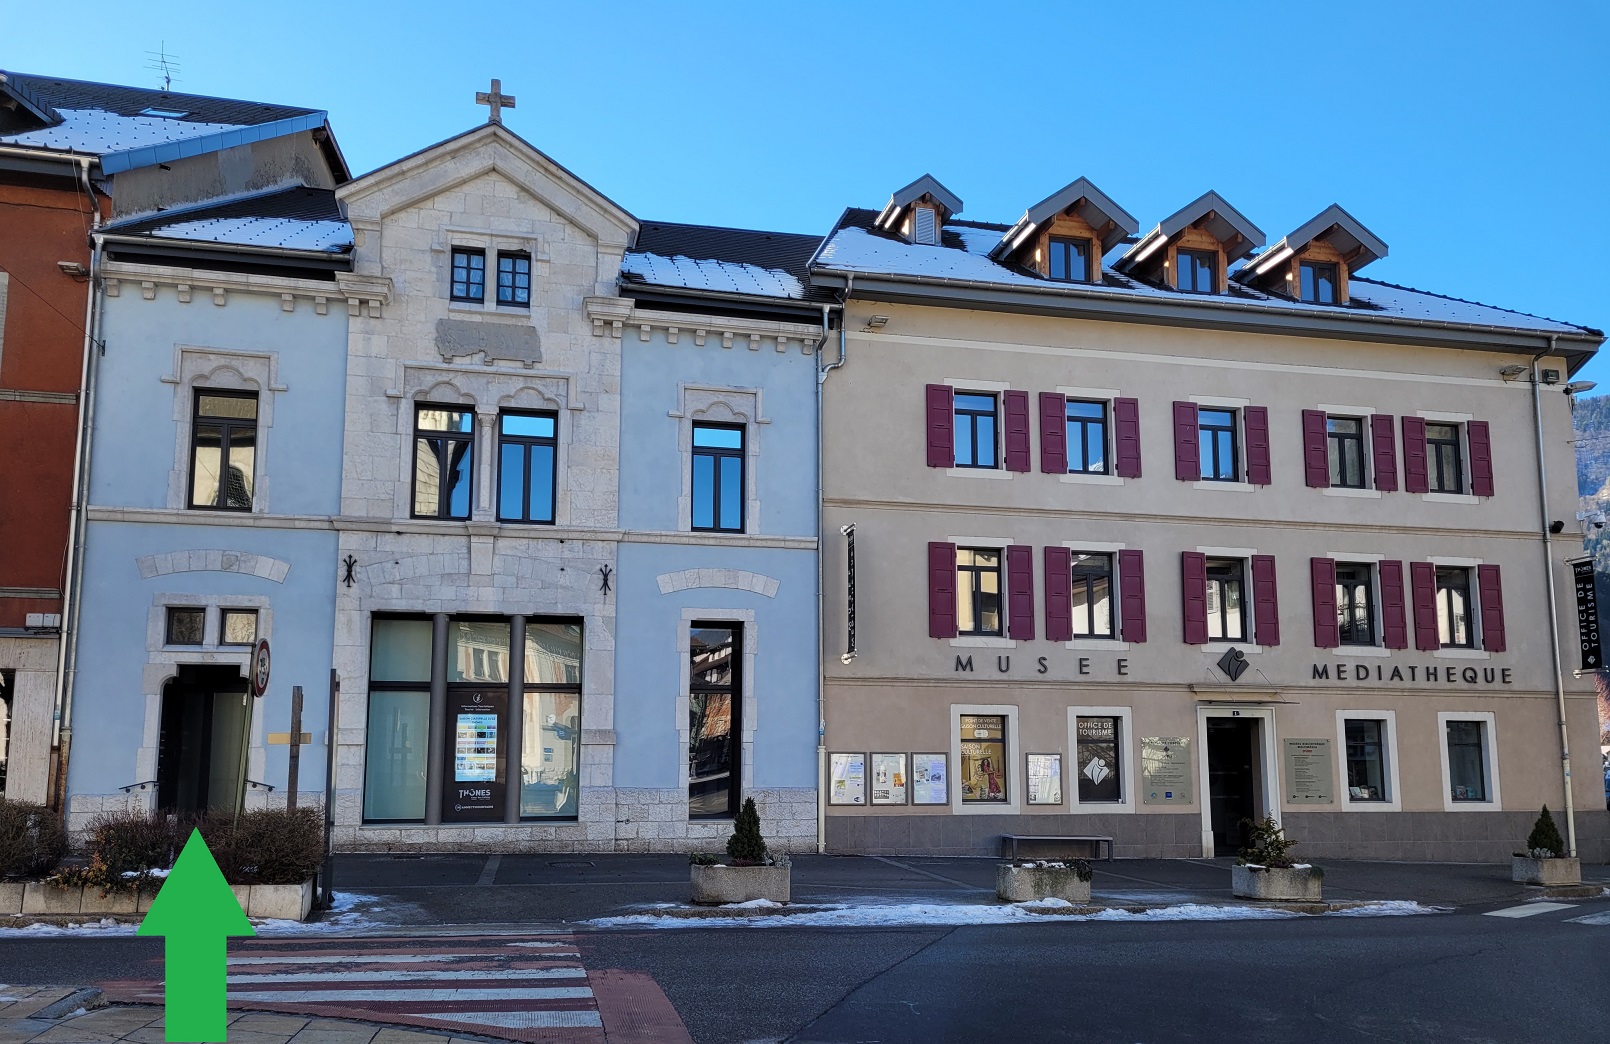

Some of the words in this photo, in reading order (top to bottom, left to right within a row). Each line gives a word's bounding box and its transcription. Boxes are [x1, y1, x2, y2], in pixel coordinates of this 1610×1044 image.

[1577, 582, 1585, 597] DE
[1586, 583, 1599, 648] TOURISME
[1579, 605, 1590, 650] OFFICE
[955, 654, 1129, 675] MUSEE
[1312, 663, 1513, 684] MEDIATHEQUE
